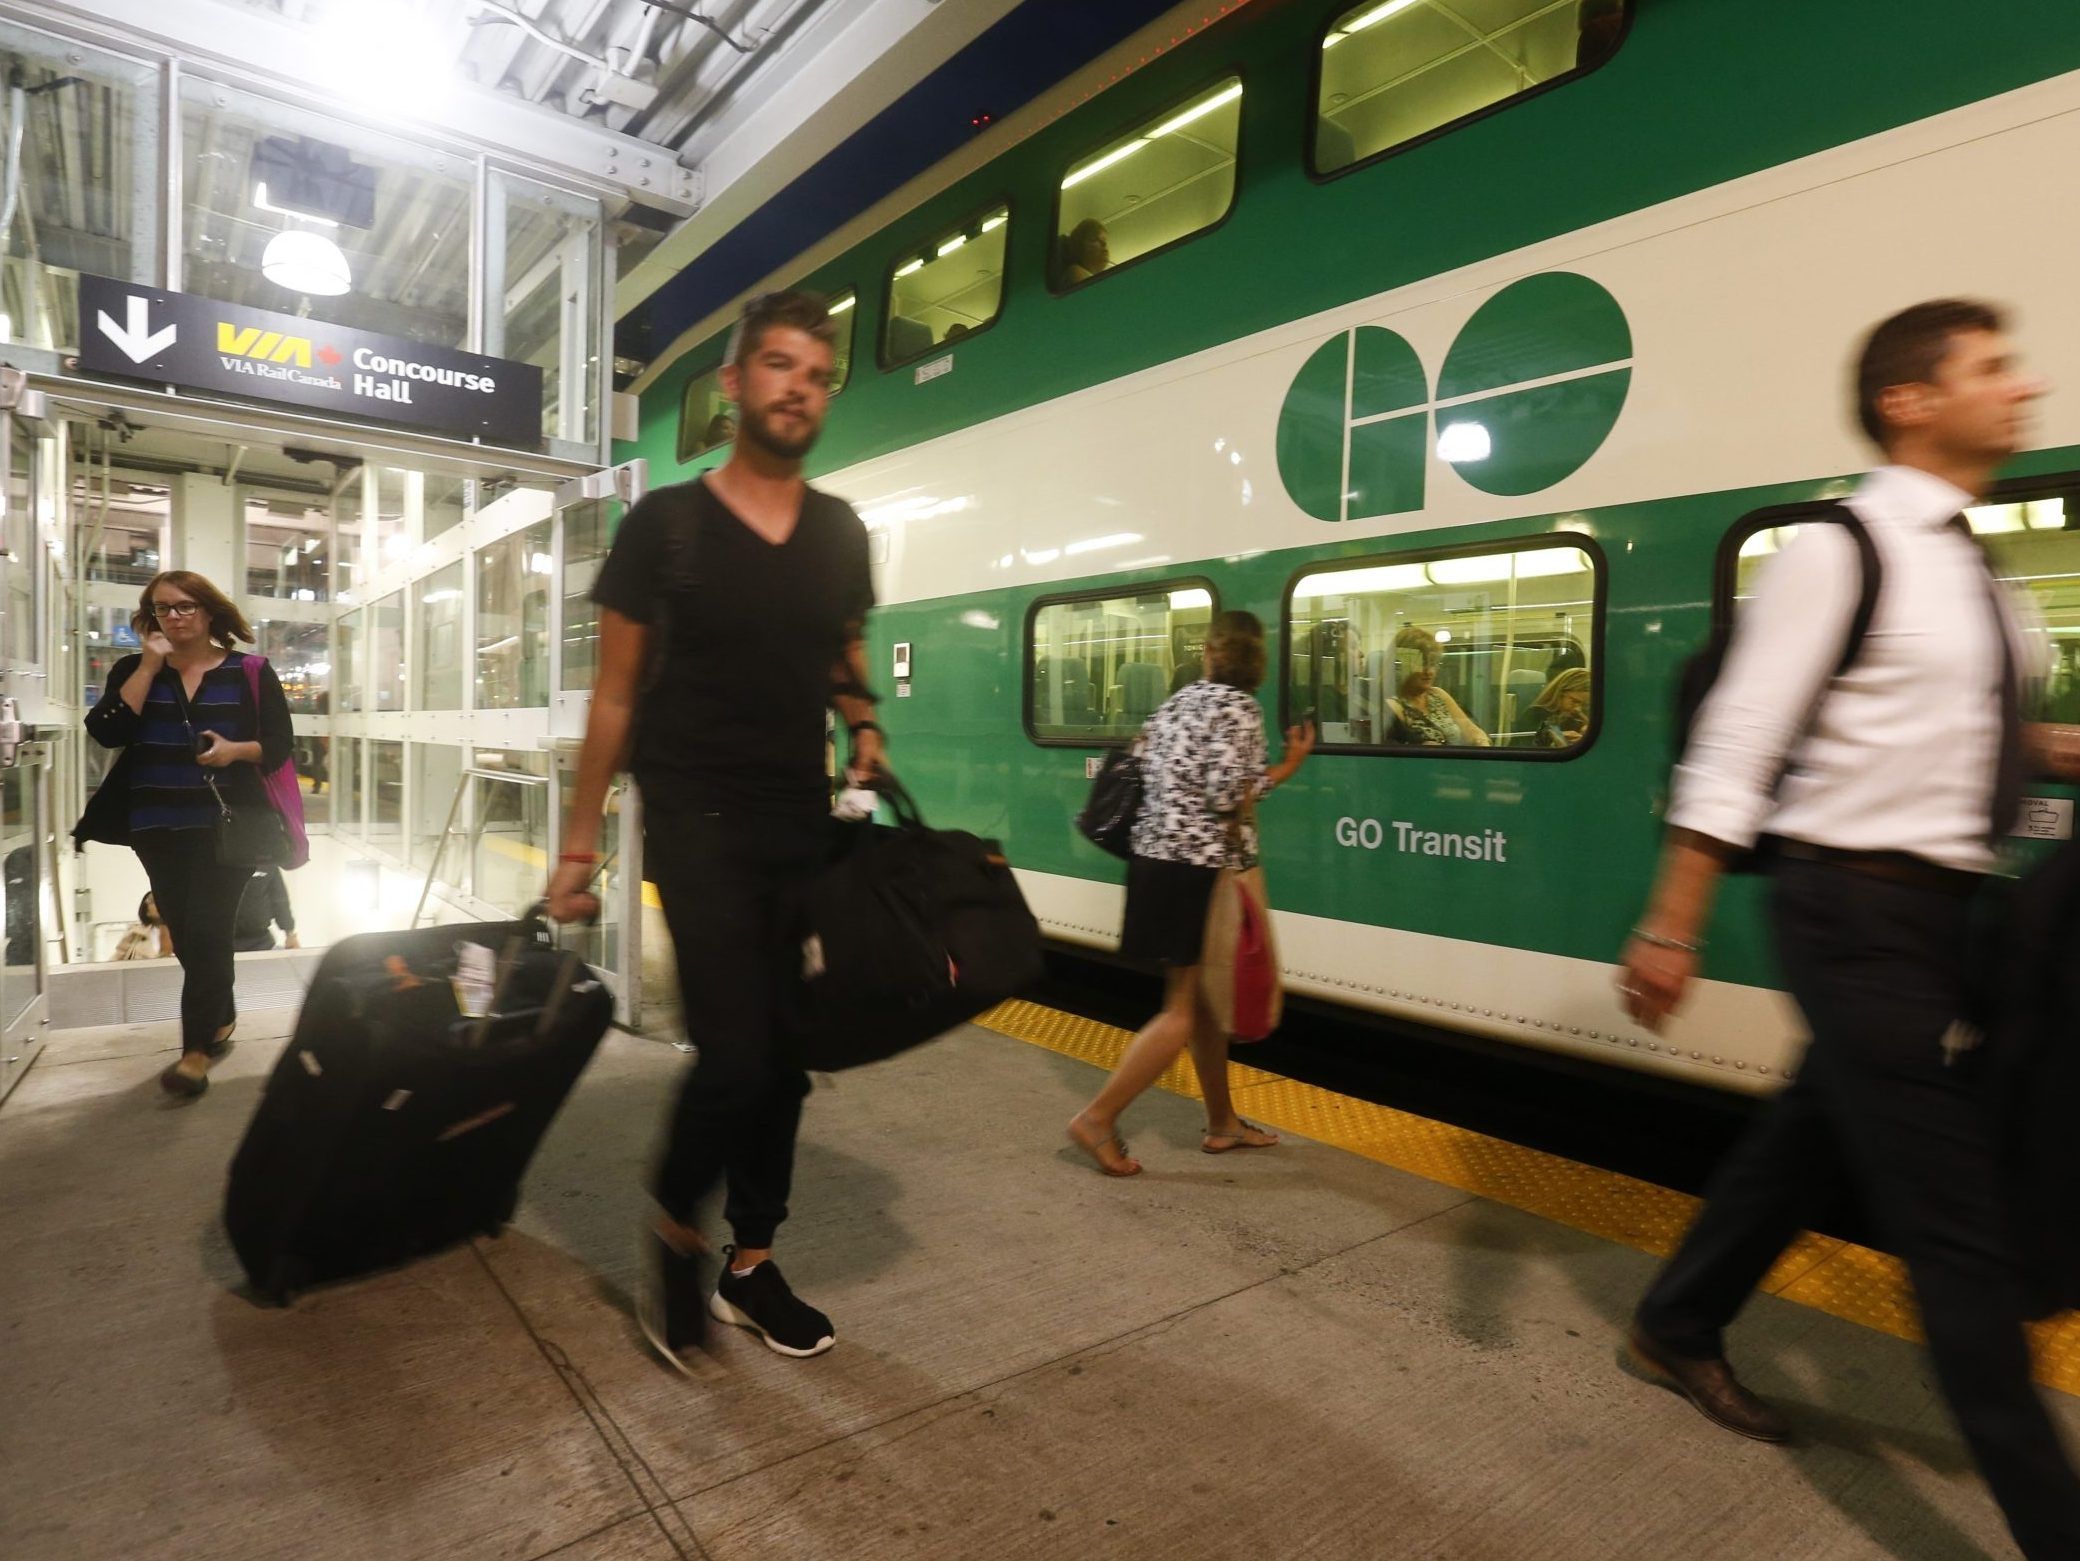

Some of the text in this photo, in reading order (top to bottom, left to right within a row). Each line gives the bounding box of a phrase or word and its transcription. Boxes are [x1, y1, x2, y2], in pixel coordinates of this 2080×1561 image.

[217, 321, 312, 369] VIA
[220, 356, 256, 375] VIA
[287, 369, 343, 390] Canada
[352, 347, 496, 394] Concourse
[353, 373, 414, 404] Hall
[1335, 816, 1508, 863] GO Transit
